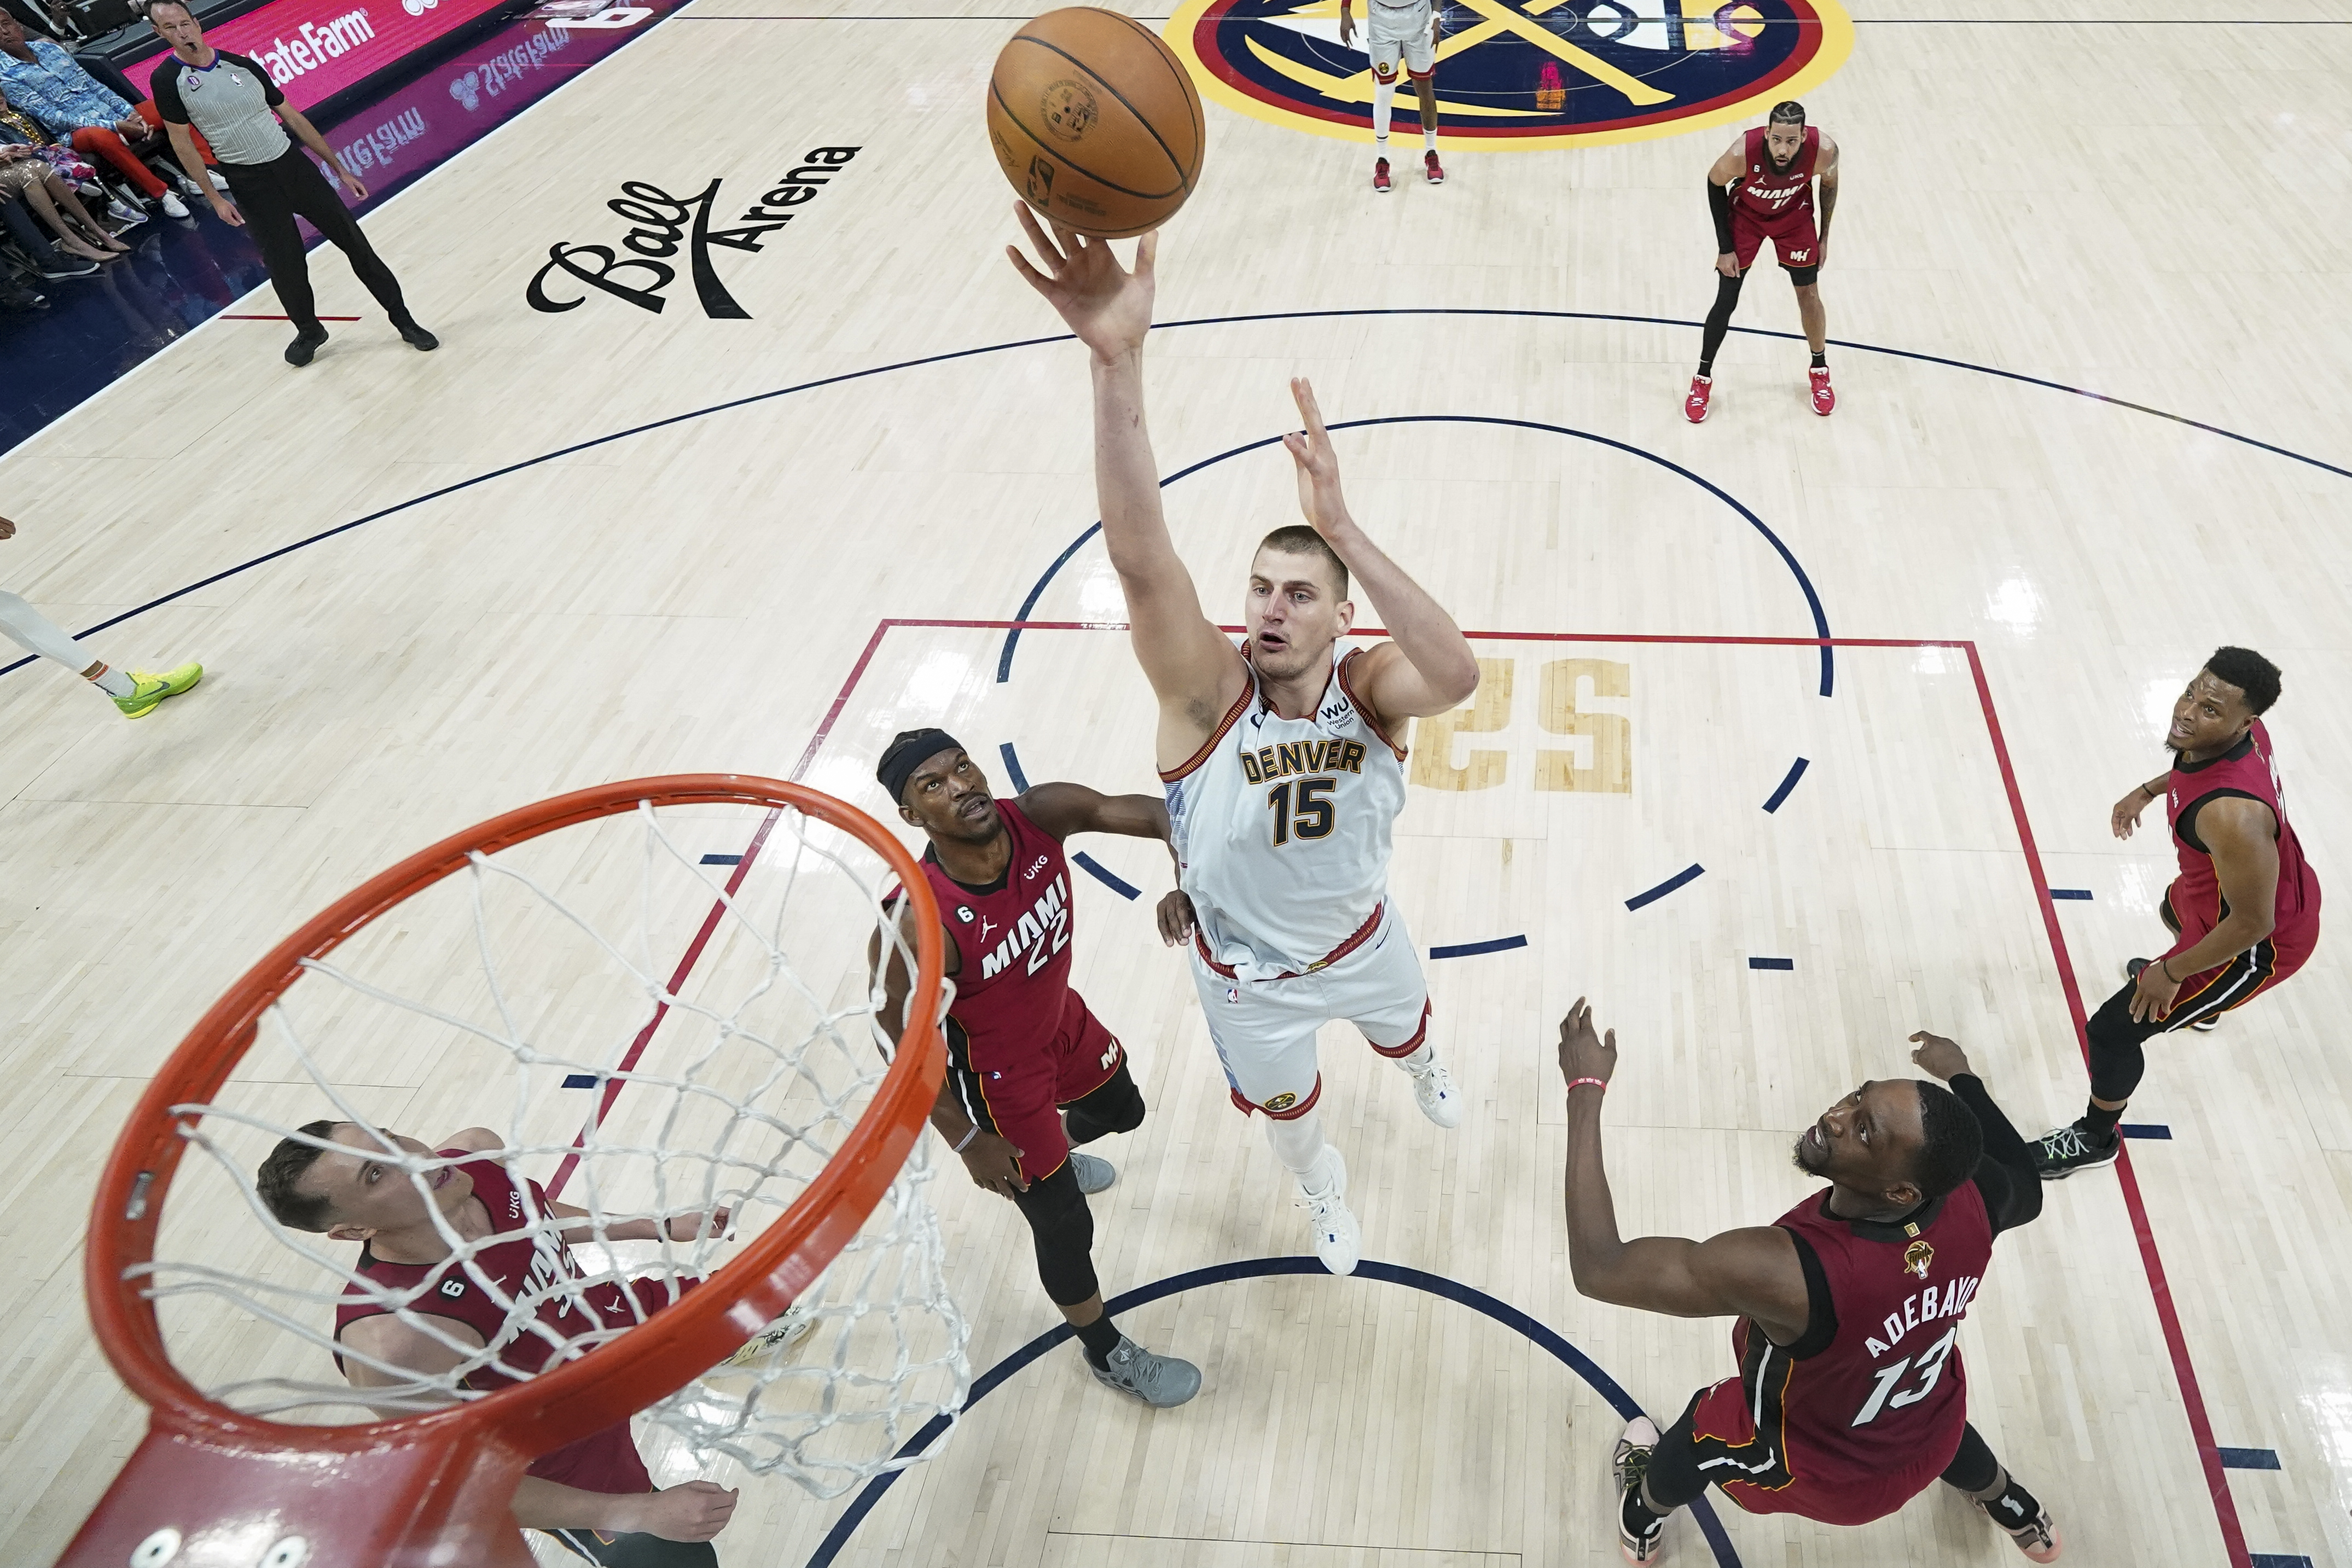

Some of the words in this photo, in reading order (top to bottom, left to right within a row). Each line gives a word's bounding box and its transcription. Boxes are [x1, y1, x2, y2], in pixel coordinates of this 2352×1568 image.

[241, 10, 375, 88] tateFarm
[1747, 183, 1806, 199] MIAMI
[526, 178, 754, 320] Ball
[706, 146, 863, 253] Arena
[1320, 696, 1349, 719] WU
[1327, 709, 1355, 725] Western
[1334, 717, 1354, 729] Union
[1240, 738, 1367, 785] DENVER
[1267, 777, 1337, 847] 15
[957, 906, 974, 923] 6
[982, 872, 1067, 980] MIAMI
[1026, 908, 1070, 977] 22
[442, 1280, 465, 1297] 6
[1864, 1275, 1979, 1359] ADEBAYO
[1851, 1326, 1956, 1427] 13
